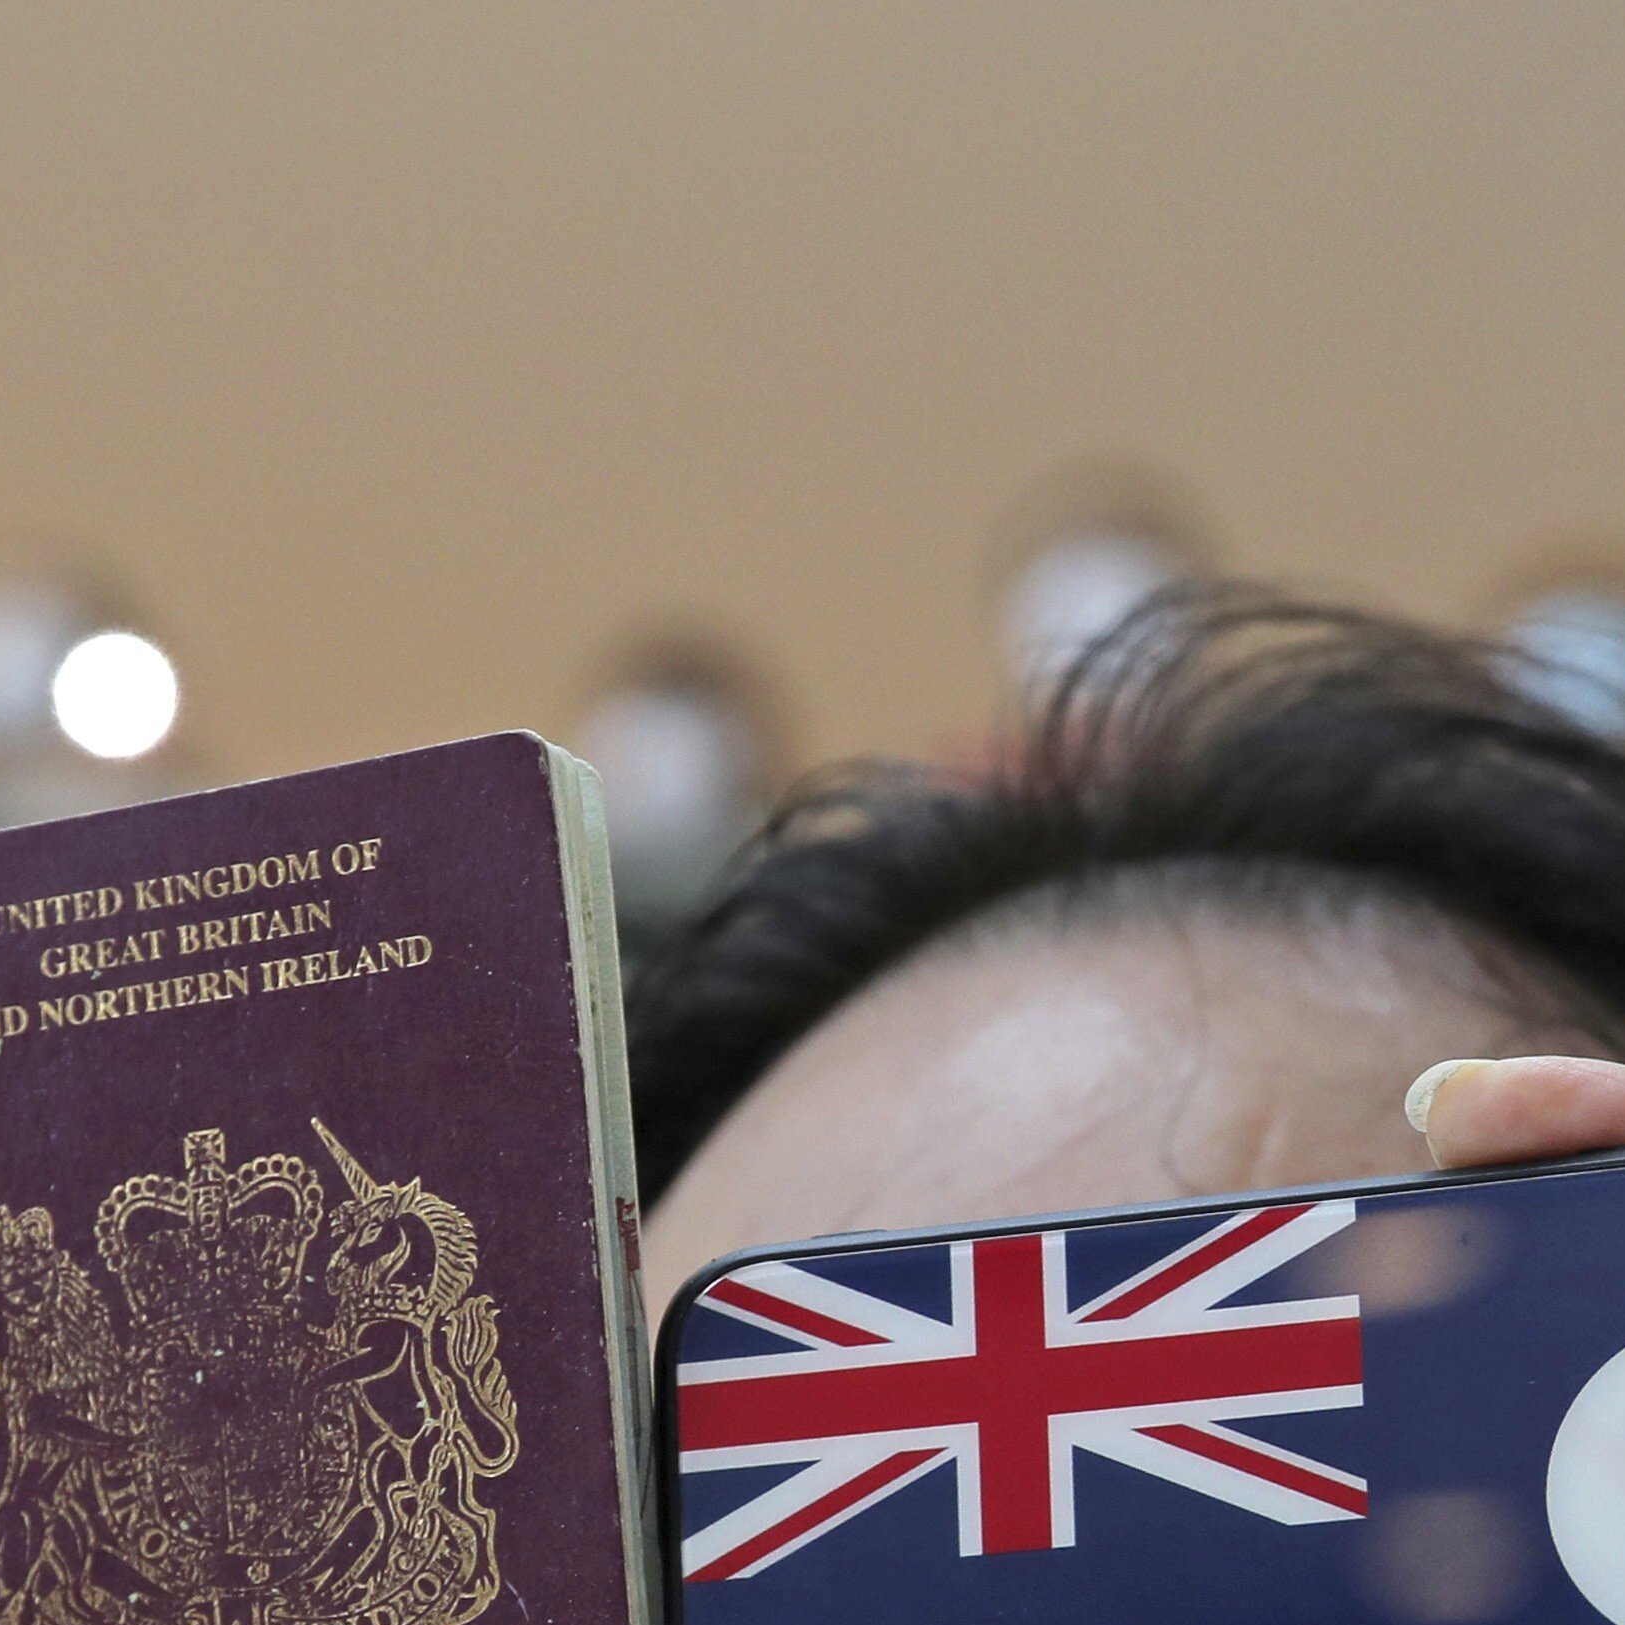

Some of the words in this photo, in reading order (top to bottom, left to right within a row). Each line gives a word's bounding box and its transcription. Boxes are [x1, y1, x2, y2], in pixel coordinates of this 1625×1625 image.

[134, 847, 323, 913] KINGDOM
[331, 837, 383, 877] OF
[39, 927, 166, 980] GREAT
[178, 900, 334, 956] BRITAIN
[38, 965, 251, 1034] NORTHERN
[261, 934, 434, 993] IRELAND
